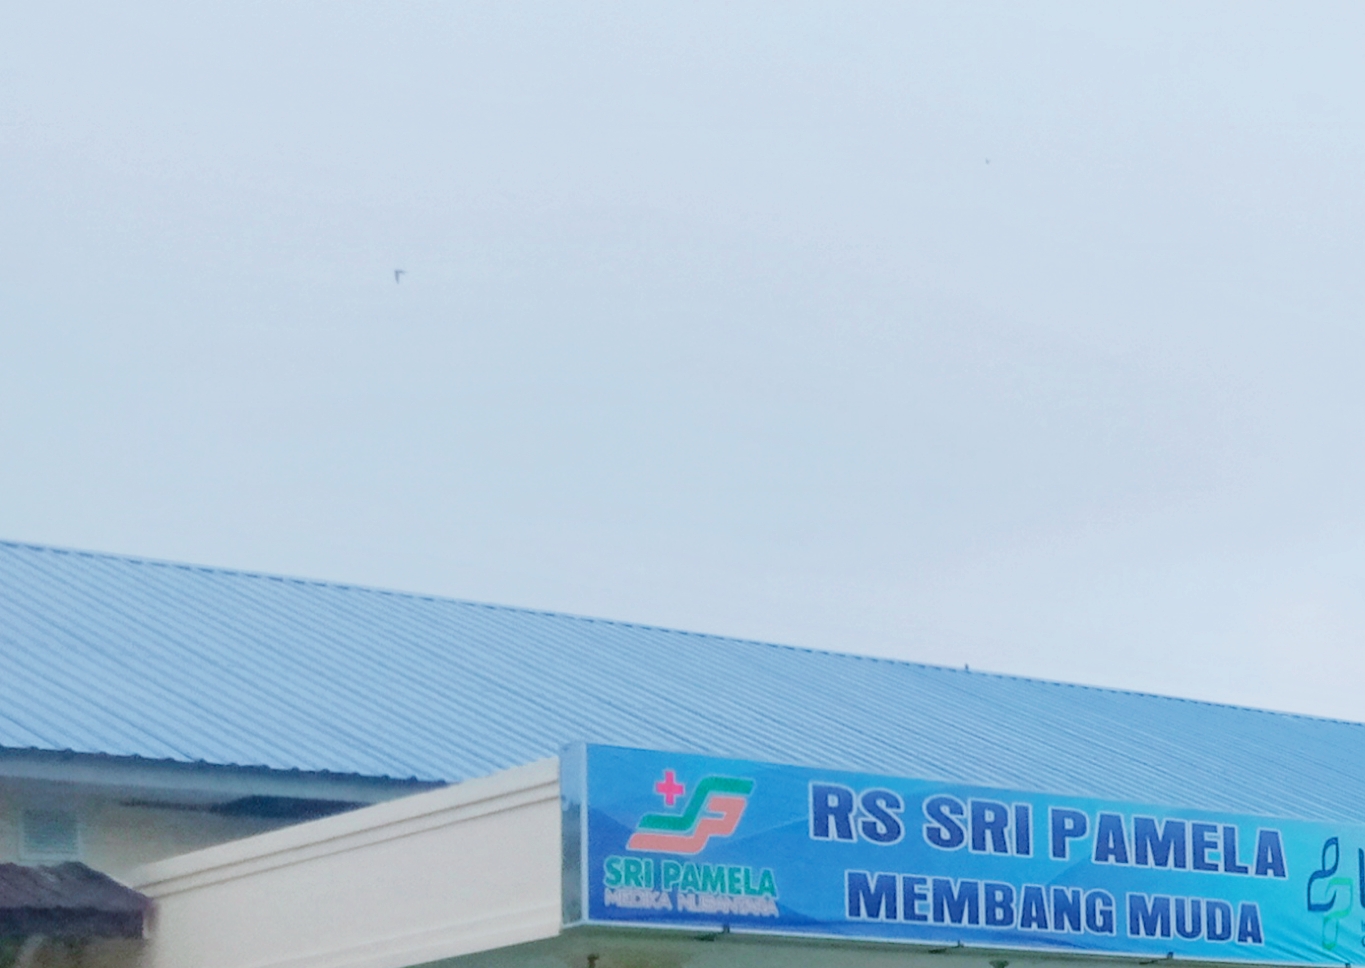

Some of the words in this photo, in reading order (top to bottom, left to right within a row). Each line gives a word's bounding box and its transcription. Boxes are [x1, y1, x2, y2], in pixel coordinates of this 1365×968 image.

[809, 783, 903, 845] RS
[923, 795, 1033, 857] SRI
[1049, 806, 1288, 879] PAMELA
[604, 855, 653, 890] SRI
[661, 859, 779, 900] PAMELA
[844, 869, 1116, 936] MEMBANG
[1127, 892, 1264, 946] MUDA
